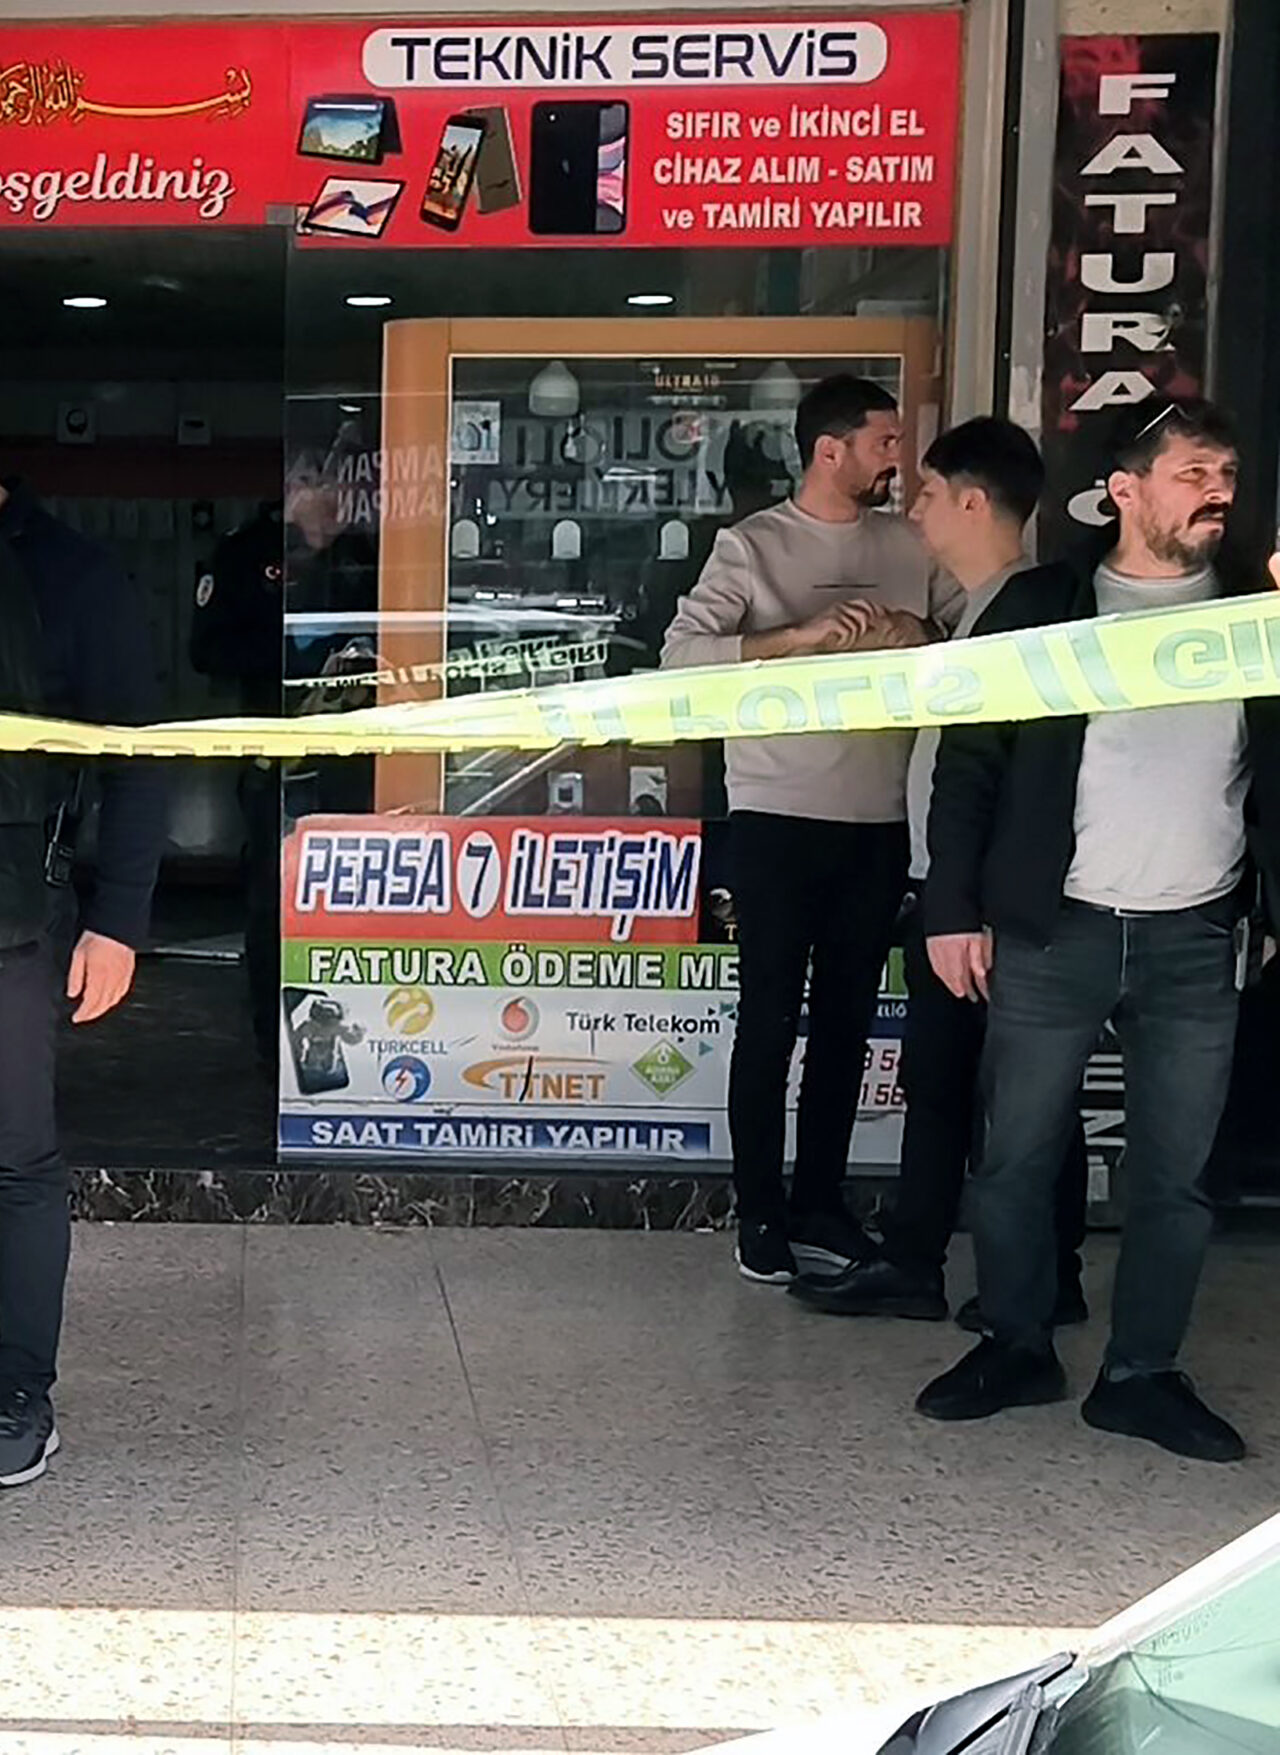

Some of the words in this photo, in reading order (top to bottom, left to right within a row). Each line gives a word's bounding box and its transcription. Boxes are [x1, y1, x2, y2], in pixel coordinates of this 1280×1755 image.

[666, 111, 741, 139] SIFIR
[749, 115, 781, 138] ve
[789, 103, 880, 138] İKİNCİ
[890, 109, 925, 136] EL
[653, 151, 742, 185] CİHAZ
[748, 156, 820, 183] ALIM
[845, 155, 934, 183] SATIM
[662, 207, 694, 229] ve
[702, 195, 801, 229] TAMİRİ
[810, 201, 922, 228] YAPILIR
[1069, 73, 1185, 411] FATURA
[301, 837, 444, 909] PERSA
[465, 844, 493, 910] 7
[310, 948, 488, 987] FATURA
[500, 945, 664, 988] ÖDEME
[566, 1011, 616, 1032] Türk
[624, 1013, 721, 1035] Telekom
[311, 1119, 403, 1146] SAAT
[546, 1126, 685, 1152] YAPILIR
